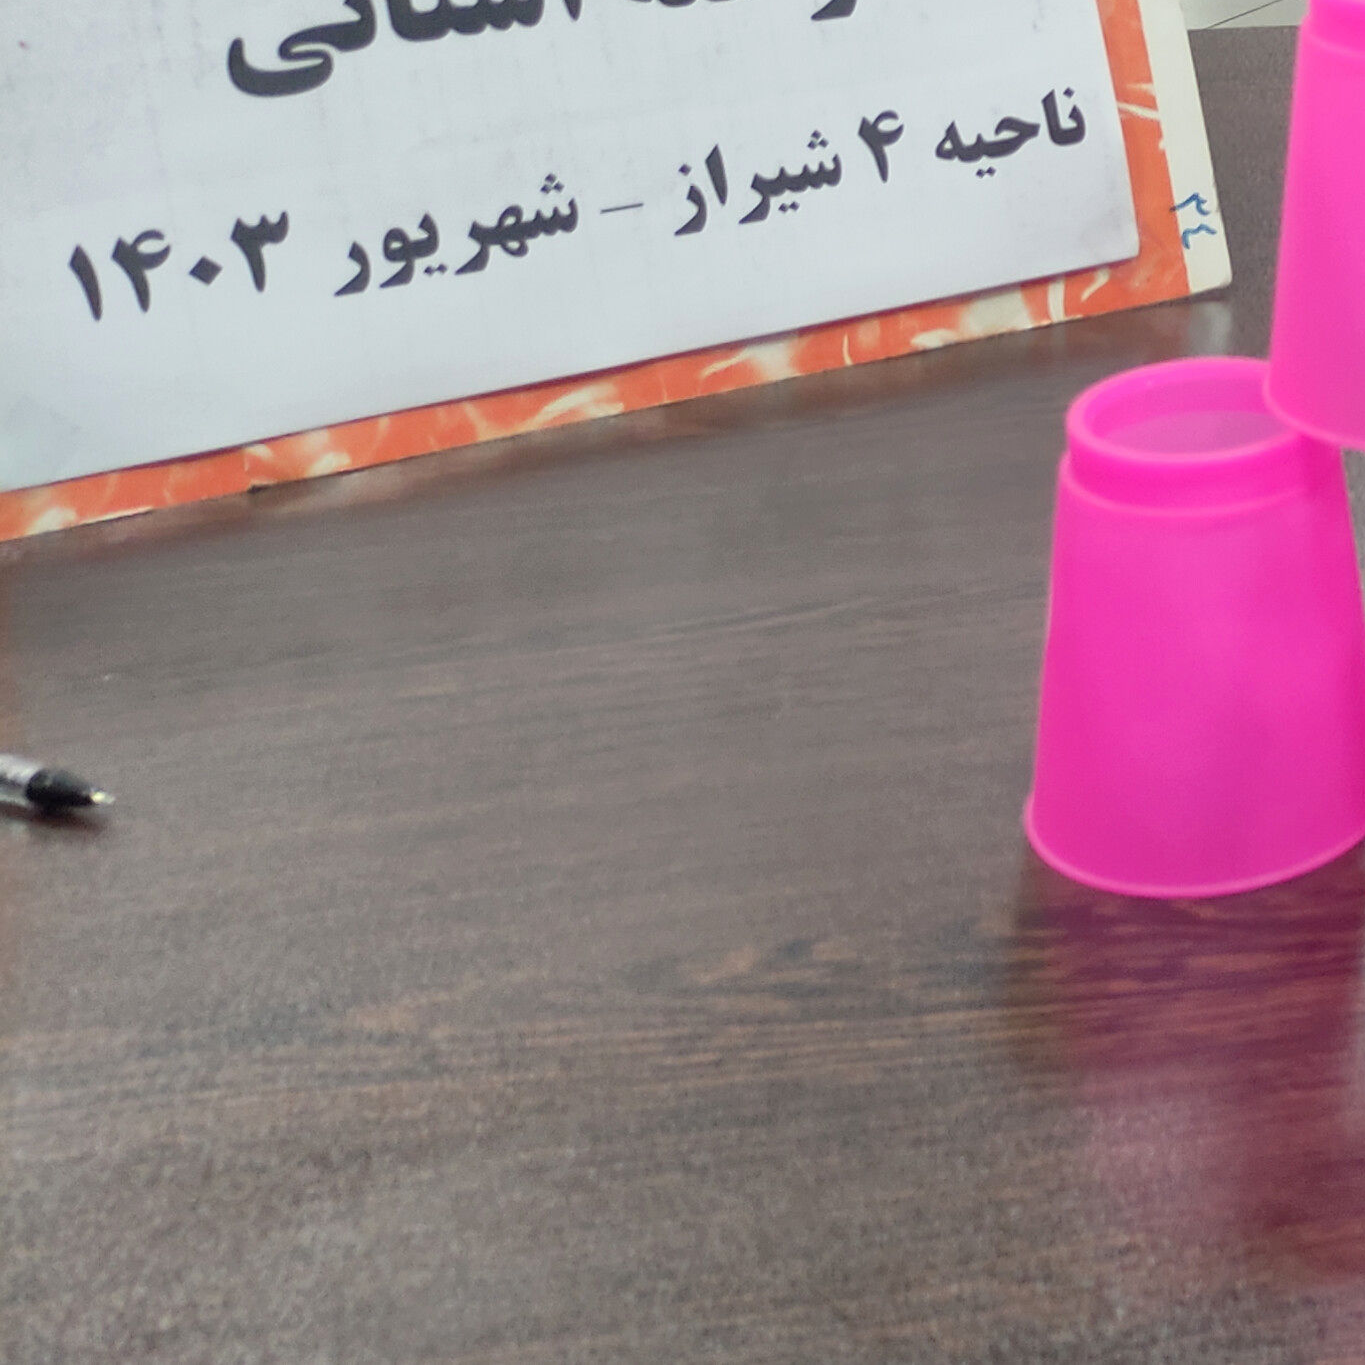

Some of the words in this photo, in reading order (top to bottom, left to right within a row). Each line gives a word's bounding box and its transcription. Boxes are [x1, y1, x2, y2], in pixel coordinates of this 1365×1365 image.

[674, 130, 842, 236] شیراز
[857, 110, 904, 183] ۴
[935, 89, 1086, 178] ناحیه
[69, 211, 289, 321] ۱۴۰۳
[334, 173, 578, 297] شهریور
